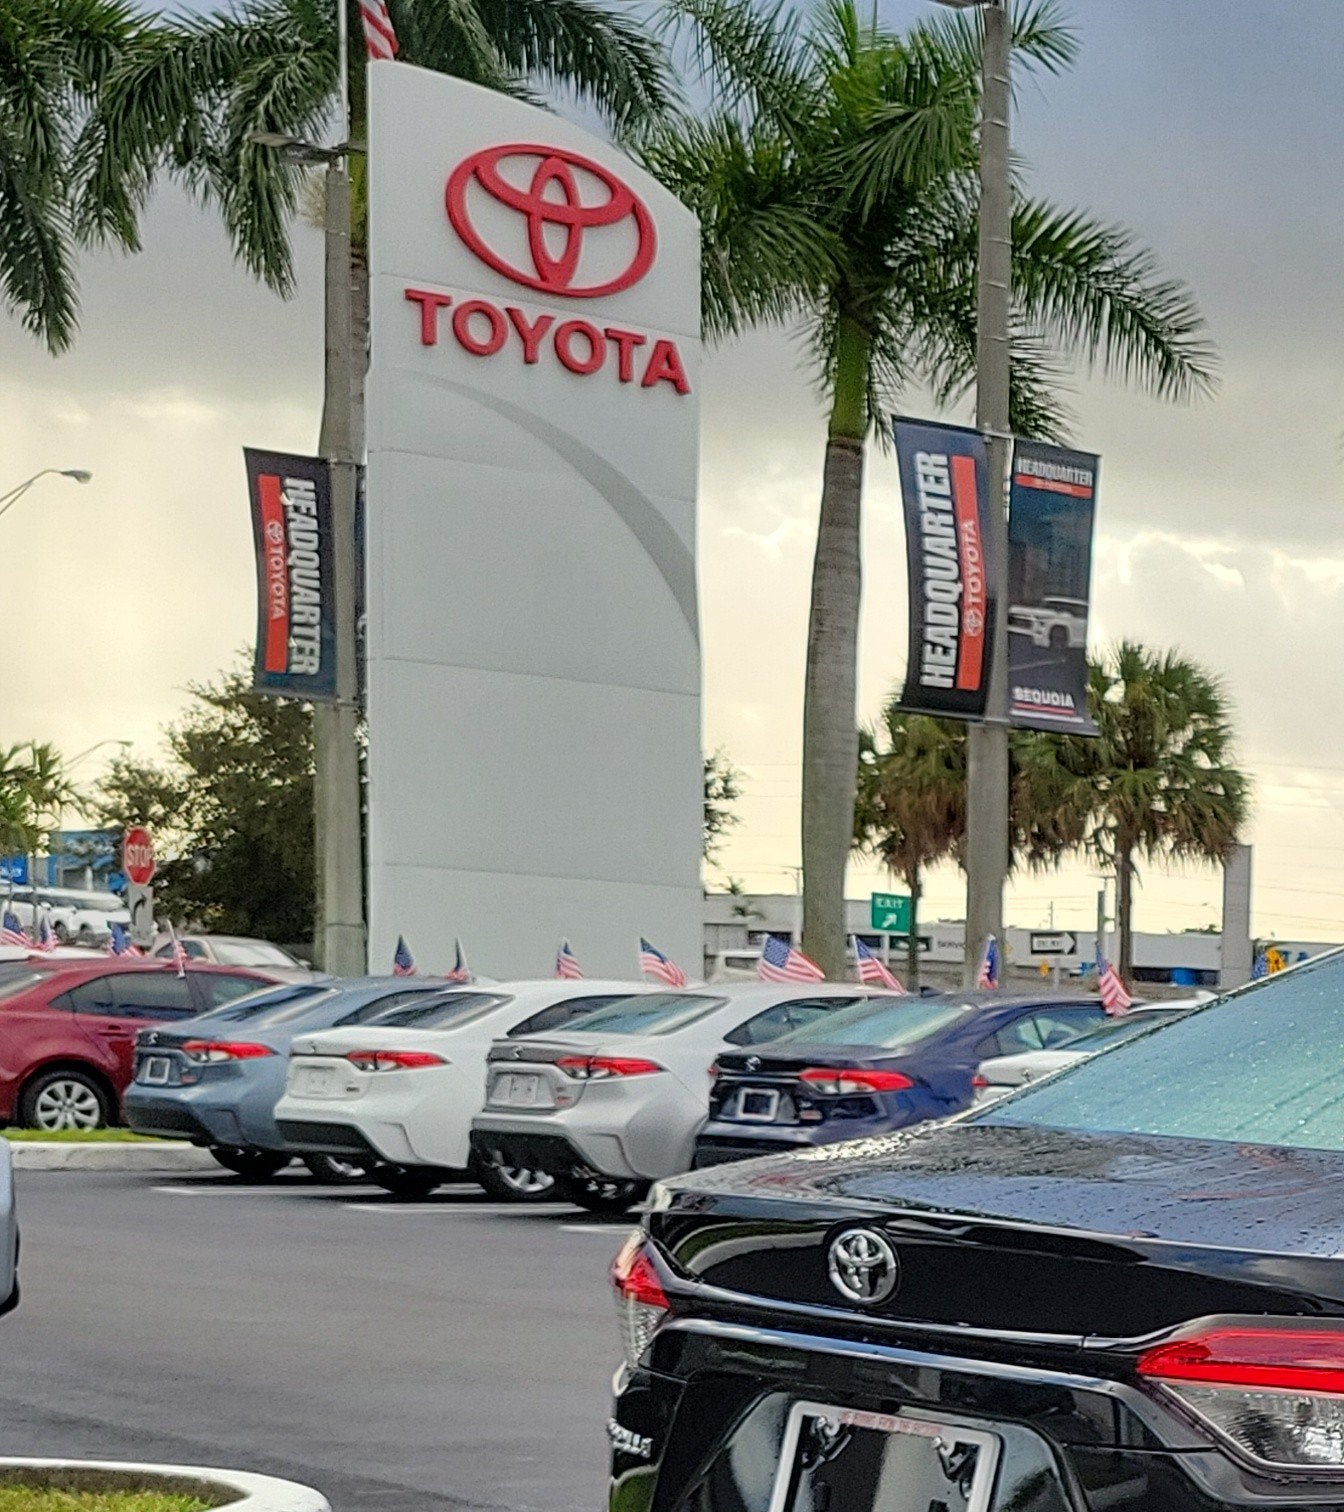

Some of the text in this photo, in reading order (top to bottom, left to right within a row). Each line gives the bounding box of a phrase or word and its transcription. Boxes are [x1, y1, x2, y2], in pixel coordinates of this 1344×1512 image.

[404, 288, 691, 395] TOYOTA
[270, 545, 286, 621] TOYOTA
[284, 477, 321, 675] HEADQUARTER
[915, 451, 962, 688] HEADQUARTER
[960, 520, 983, 607] TOYOTA
[1012, 686, 1075, 708] SEQUOIA
